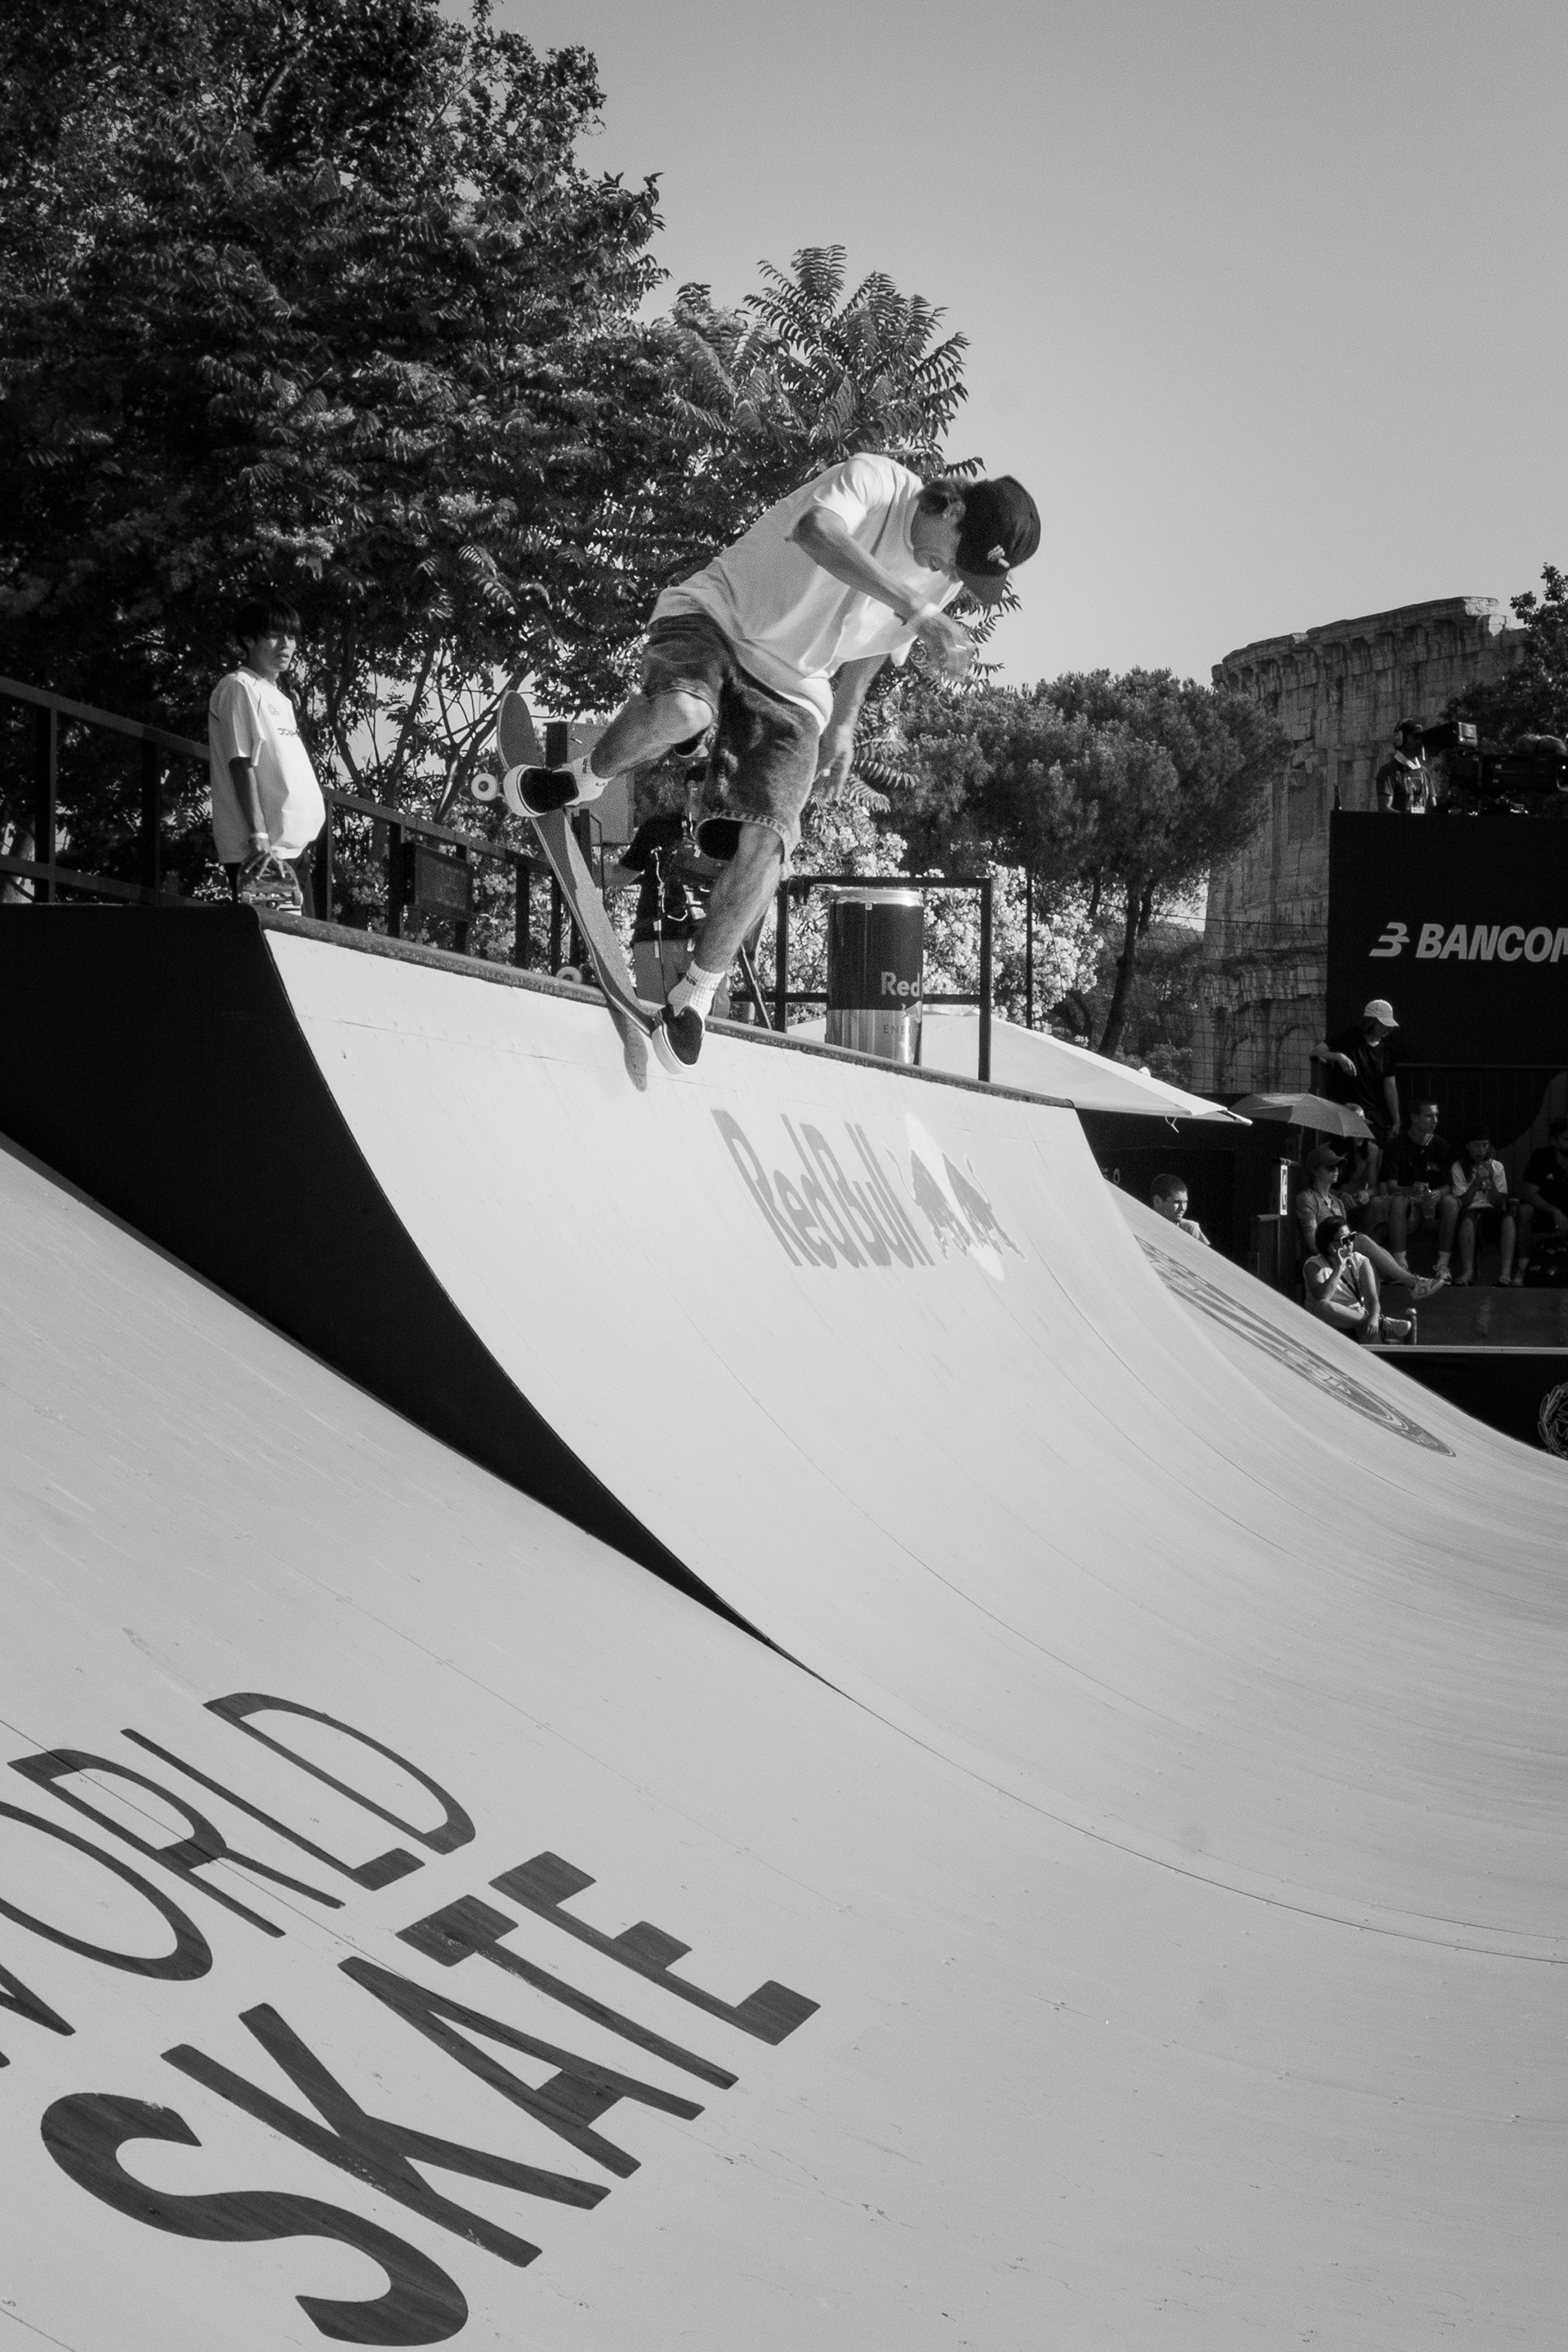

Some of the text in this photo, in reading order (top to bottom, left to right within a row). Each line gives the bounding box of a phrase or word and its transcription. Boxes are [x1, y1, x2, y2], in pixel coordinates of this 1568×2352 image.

[881, 971, 920, 997] Red
[0, 1692, 475, 2067] ORLD
[41, 1851, 821, 2345] SKATE
